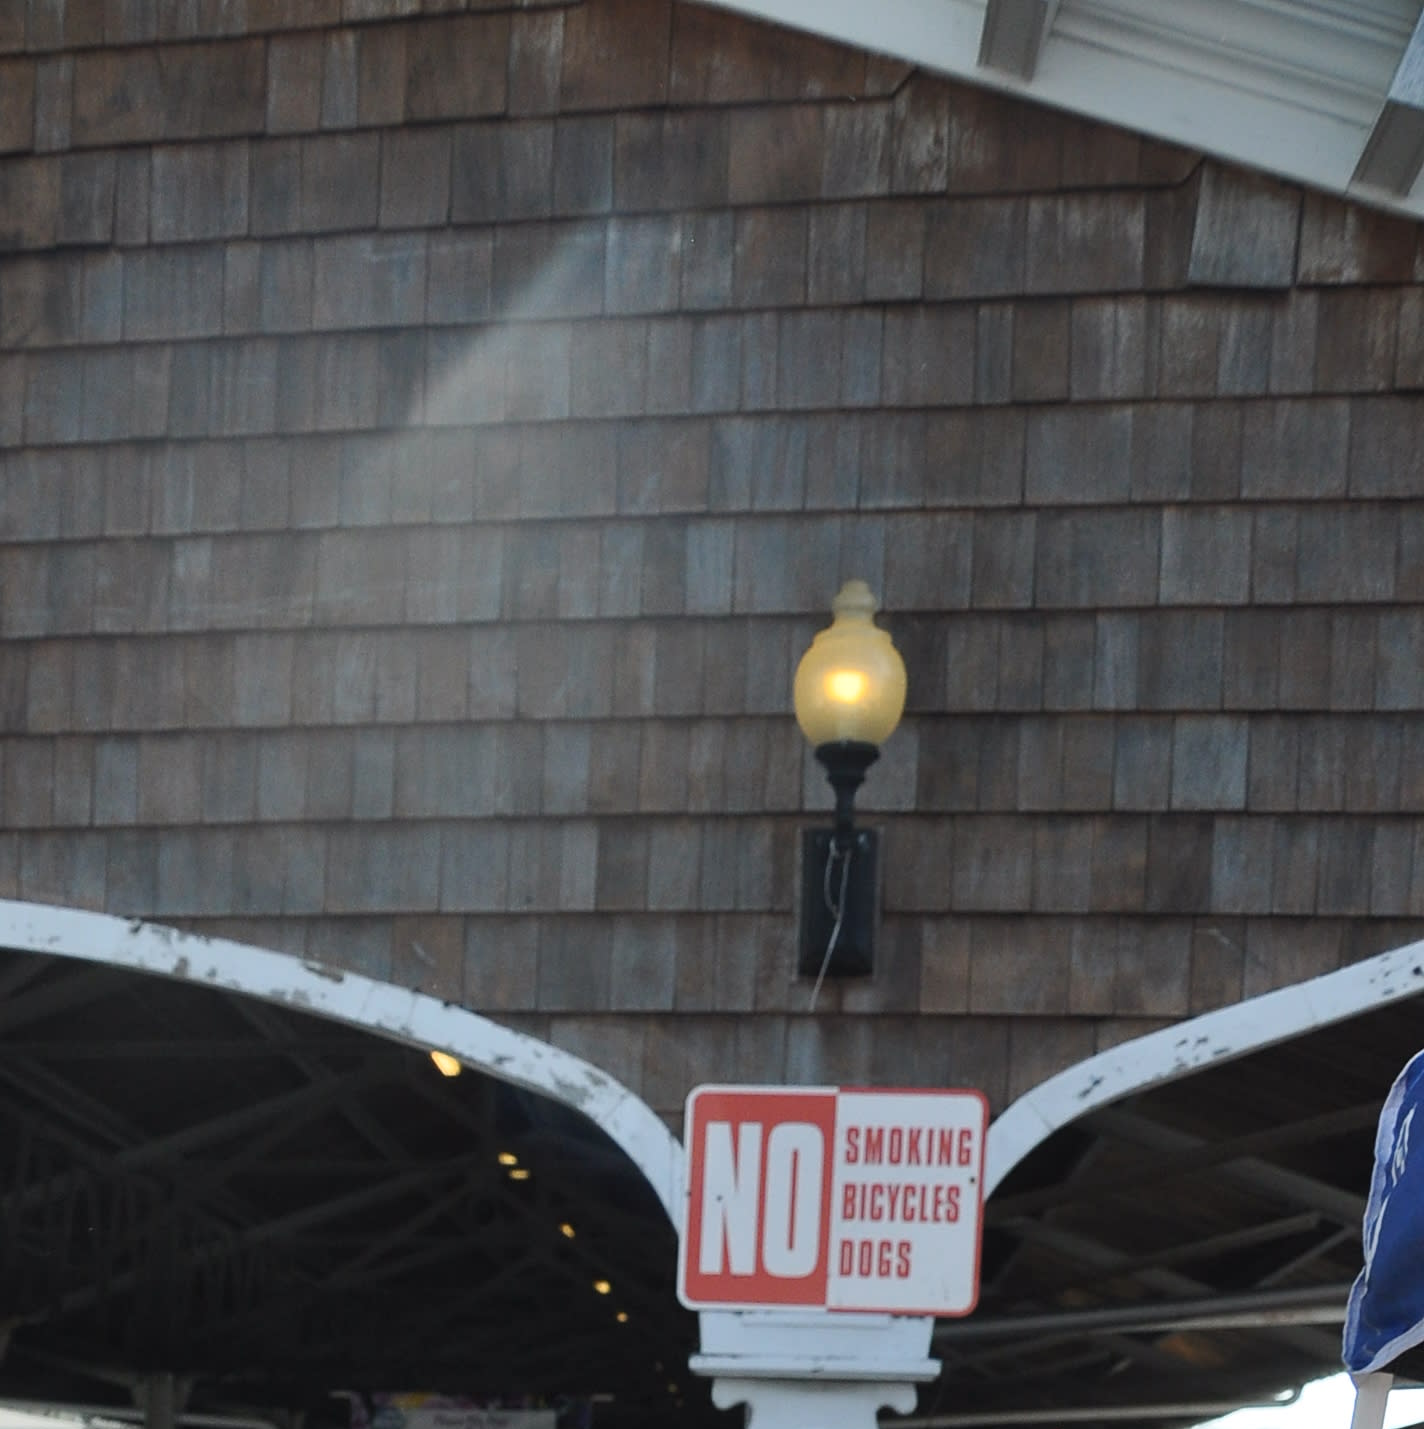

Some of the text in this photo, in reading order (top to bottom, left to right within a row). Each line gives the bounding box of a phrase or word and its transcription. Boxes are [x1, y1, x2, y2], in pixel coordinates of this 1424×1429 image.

[843, 1127, 973, 1168] SMOKING
[698, 1121, 827, 1279] NO
[841, 1183, 961, 1224] BICYCLES
[839, 1239, 913, 1279] DOGS
